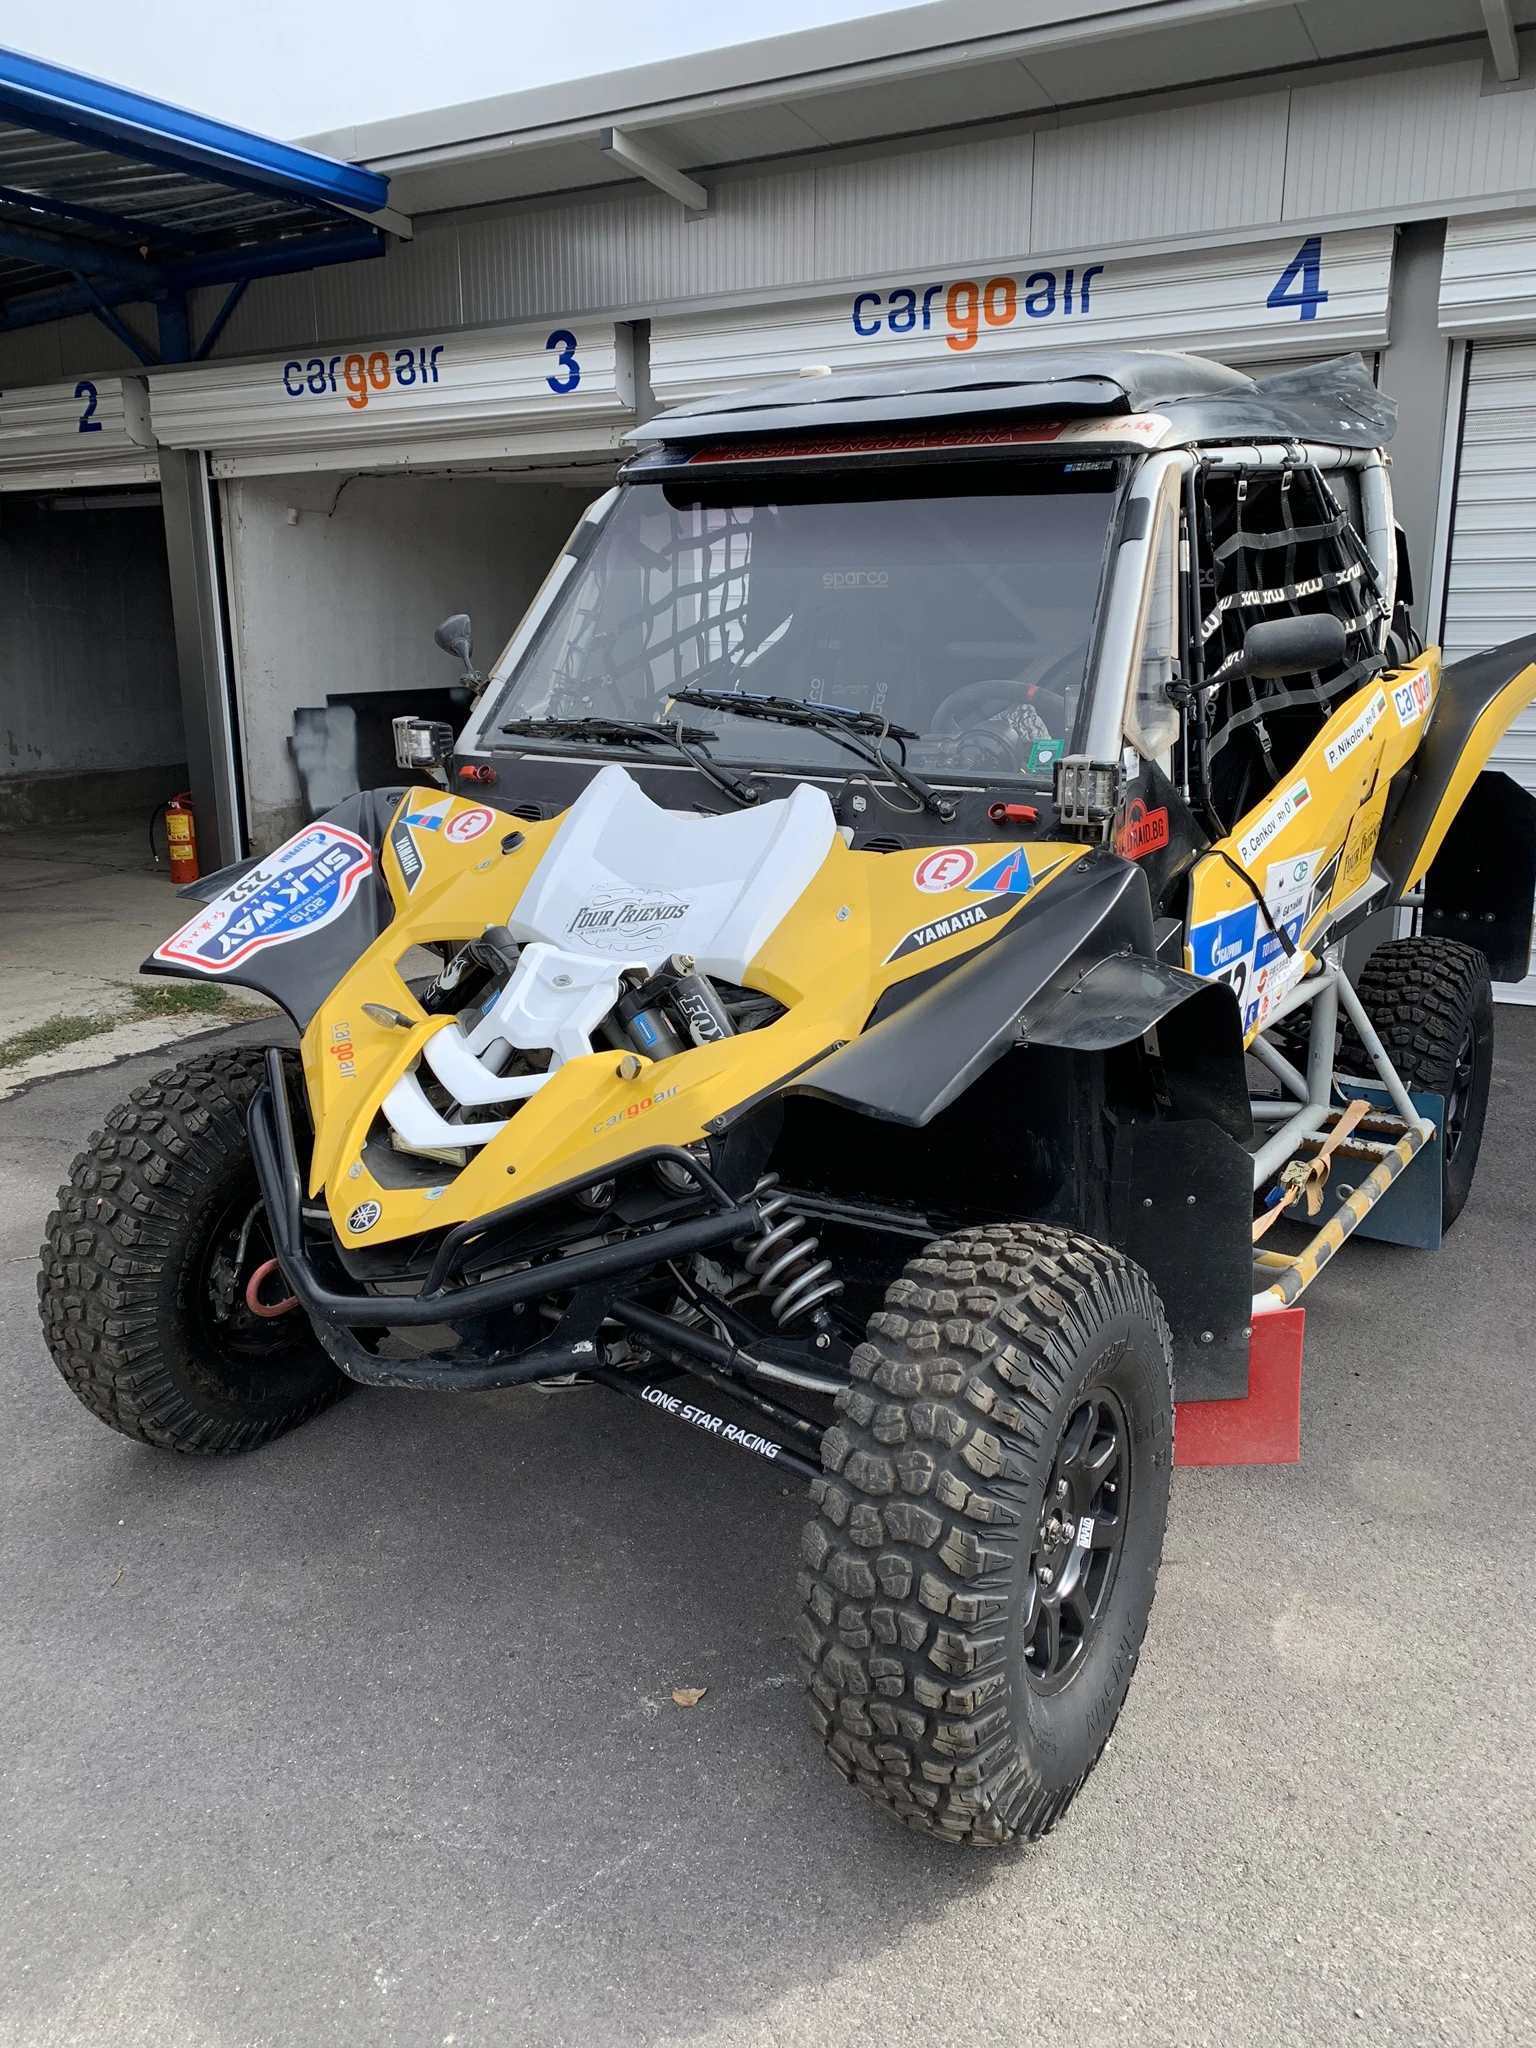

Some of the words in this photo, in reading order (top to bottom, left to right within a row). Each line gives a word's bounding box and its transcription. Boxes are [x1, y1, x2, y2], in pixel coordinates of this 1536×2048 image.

[1268, 238, 1330, 322] 4
[853, 265, 1105, 352] cargoair
[283, 345, 445, 411] cargoair
[546, 330, 582, 395] 3
[74, 381, 103, 434] 2
[822, 570, 888, 589] sparco
[1329, 750, 1338, 764] P.
[1337, 724, 1364, 756] Nikolov
[395, 835, 420, 876] YAMAHA
[1241, 847, 1251, 861] P.
[1249, 819, 1276, 851] Cenkov
[222, 870, 272, 903] 232
[277, 847, 352, 905] SILK
[931, 857, 959, 881] E
[241, 872, 295, 916] RALLY
[289, 896, 328, 924] 2019
[217, 900, 286, 955] WAY
[567, 907, 614, 933] FOUR
[612, 904, 690, 927] FRIENDS
[913, 906, 988, 946] YAMAHA
[329, 1022, 357, 1079] cargoair
[592, 1083, 680, 1135] cargoair
[641, 1385, 683, 1413] LONE
[680, 1403, 724, 1433] STAR
[722, 1423, 782, 1459] RACING
[1078, 1517, 1095, 1548] BRAID
